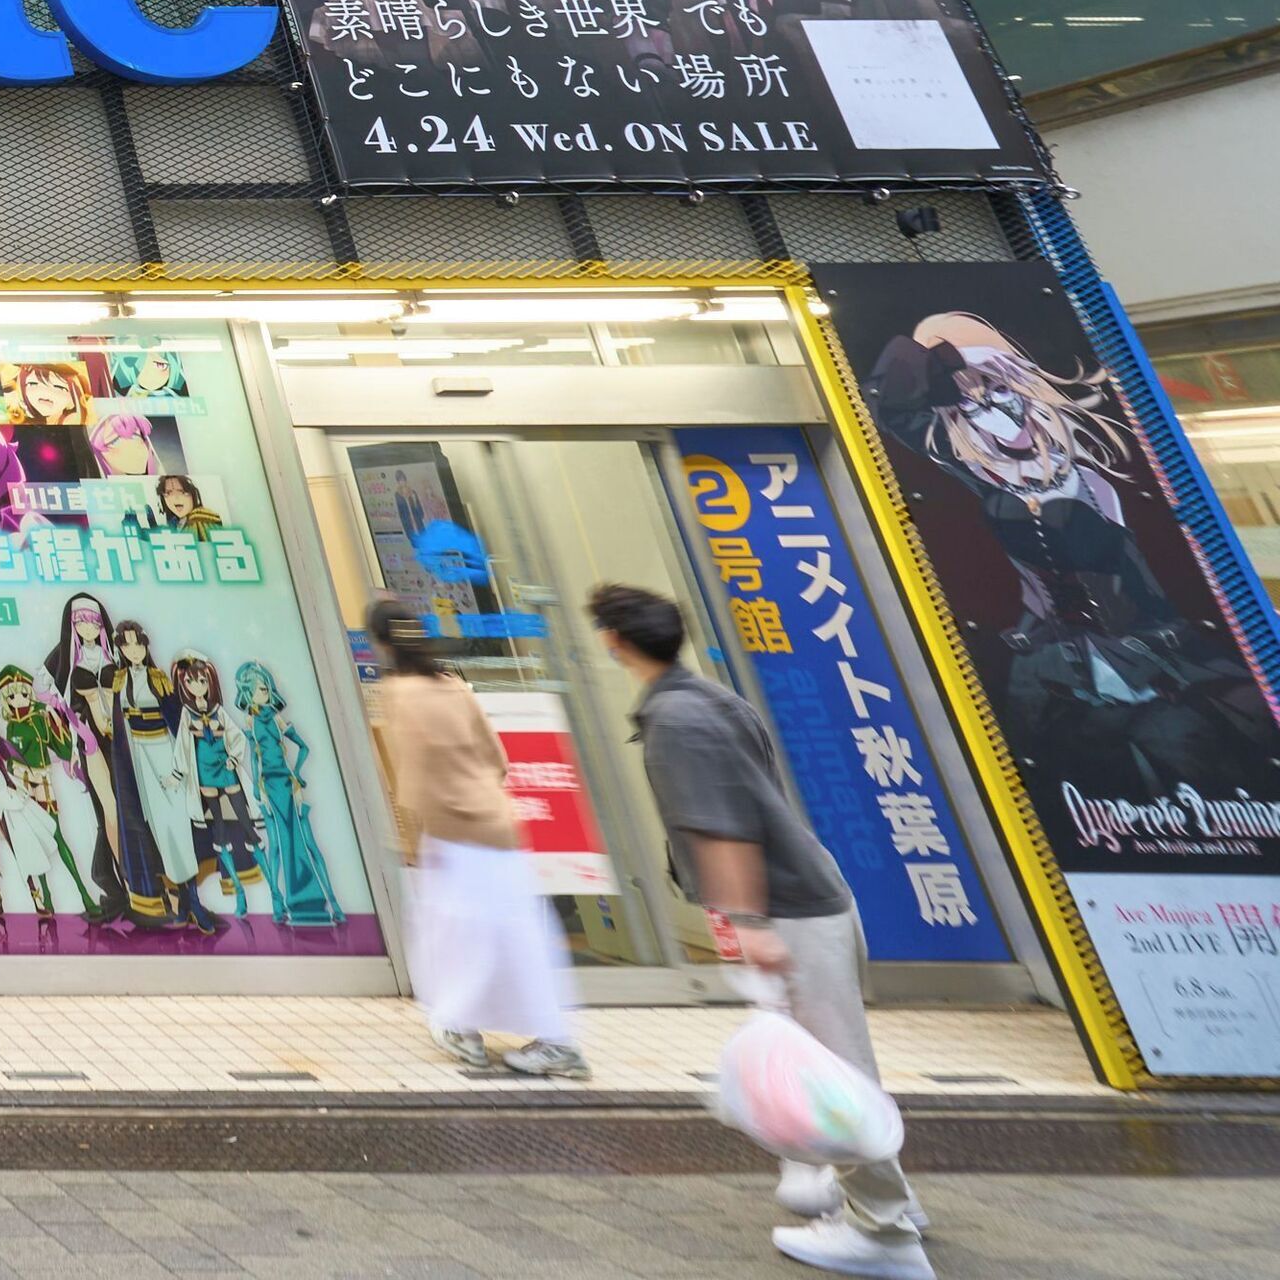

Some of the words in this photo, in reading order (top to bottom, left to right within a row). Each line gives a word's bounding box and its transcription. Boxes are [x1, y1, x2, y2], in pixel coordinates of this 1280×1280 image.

[342, 53, 791, 101] どこにもない場所
[363, 113, 498, 155] 4.24
[509, 122, 613, 155] Wed.
[623, 120, 692, 154] ON
[698, 120, 819, 154] SALE
[748, 452, 978, 930] アニメイト秋葉原
[1166, 932, 1228, 956] LIVE
[1215, 901, 1280, 957] 開
